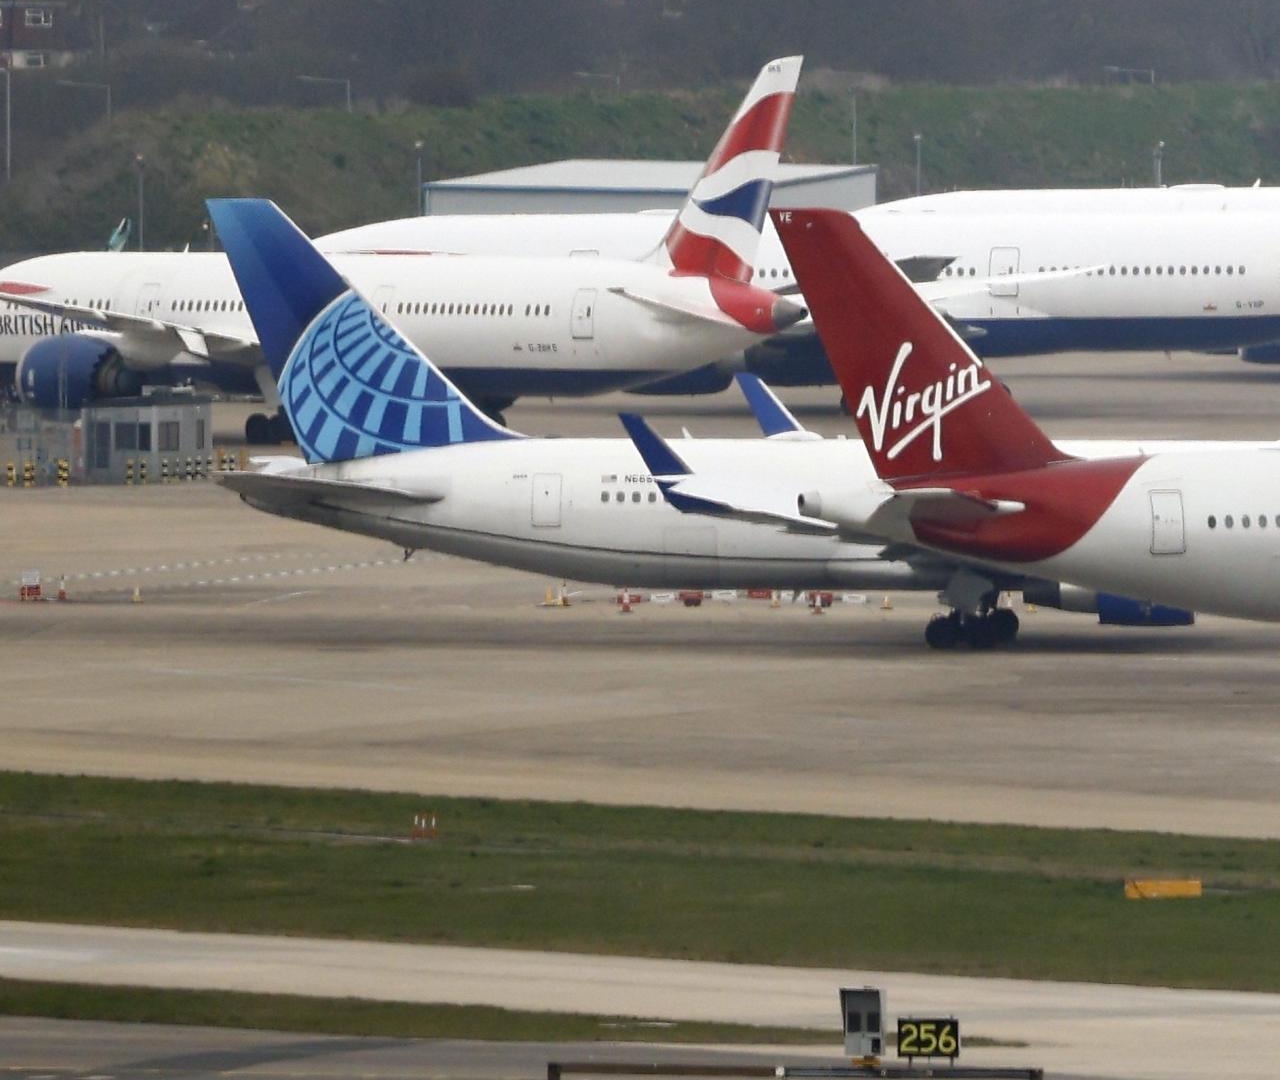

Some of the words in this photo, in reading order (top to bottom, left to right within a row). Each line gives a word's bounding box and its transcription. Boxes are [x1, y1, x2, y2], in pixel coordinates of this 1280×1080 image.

[780, 211, 792, 224] VE
[856, 341, 992, 461] Virgin
[900, 1023, 957, 1054] 256
